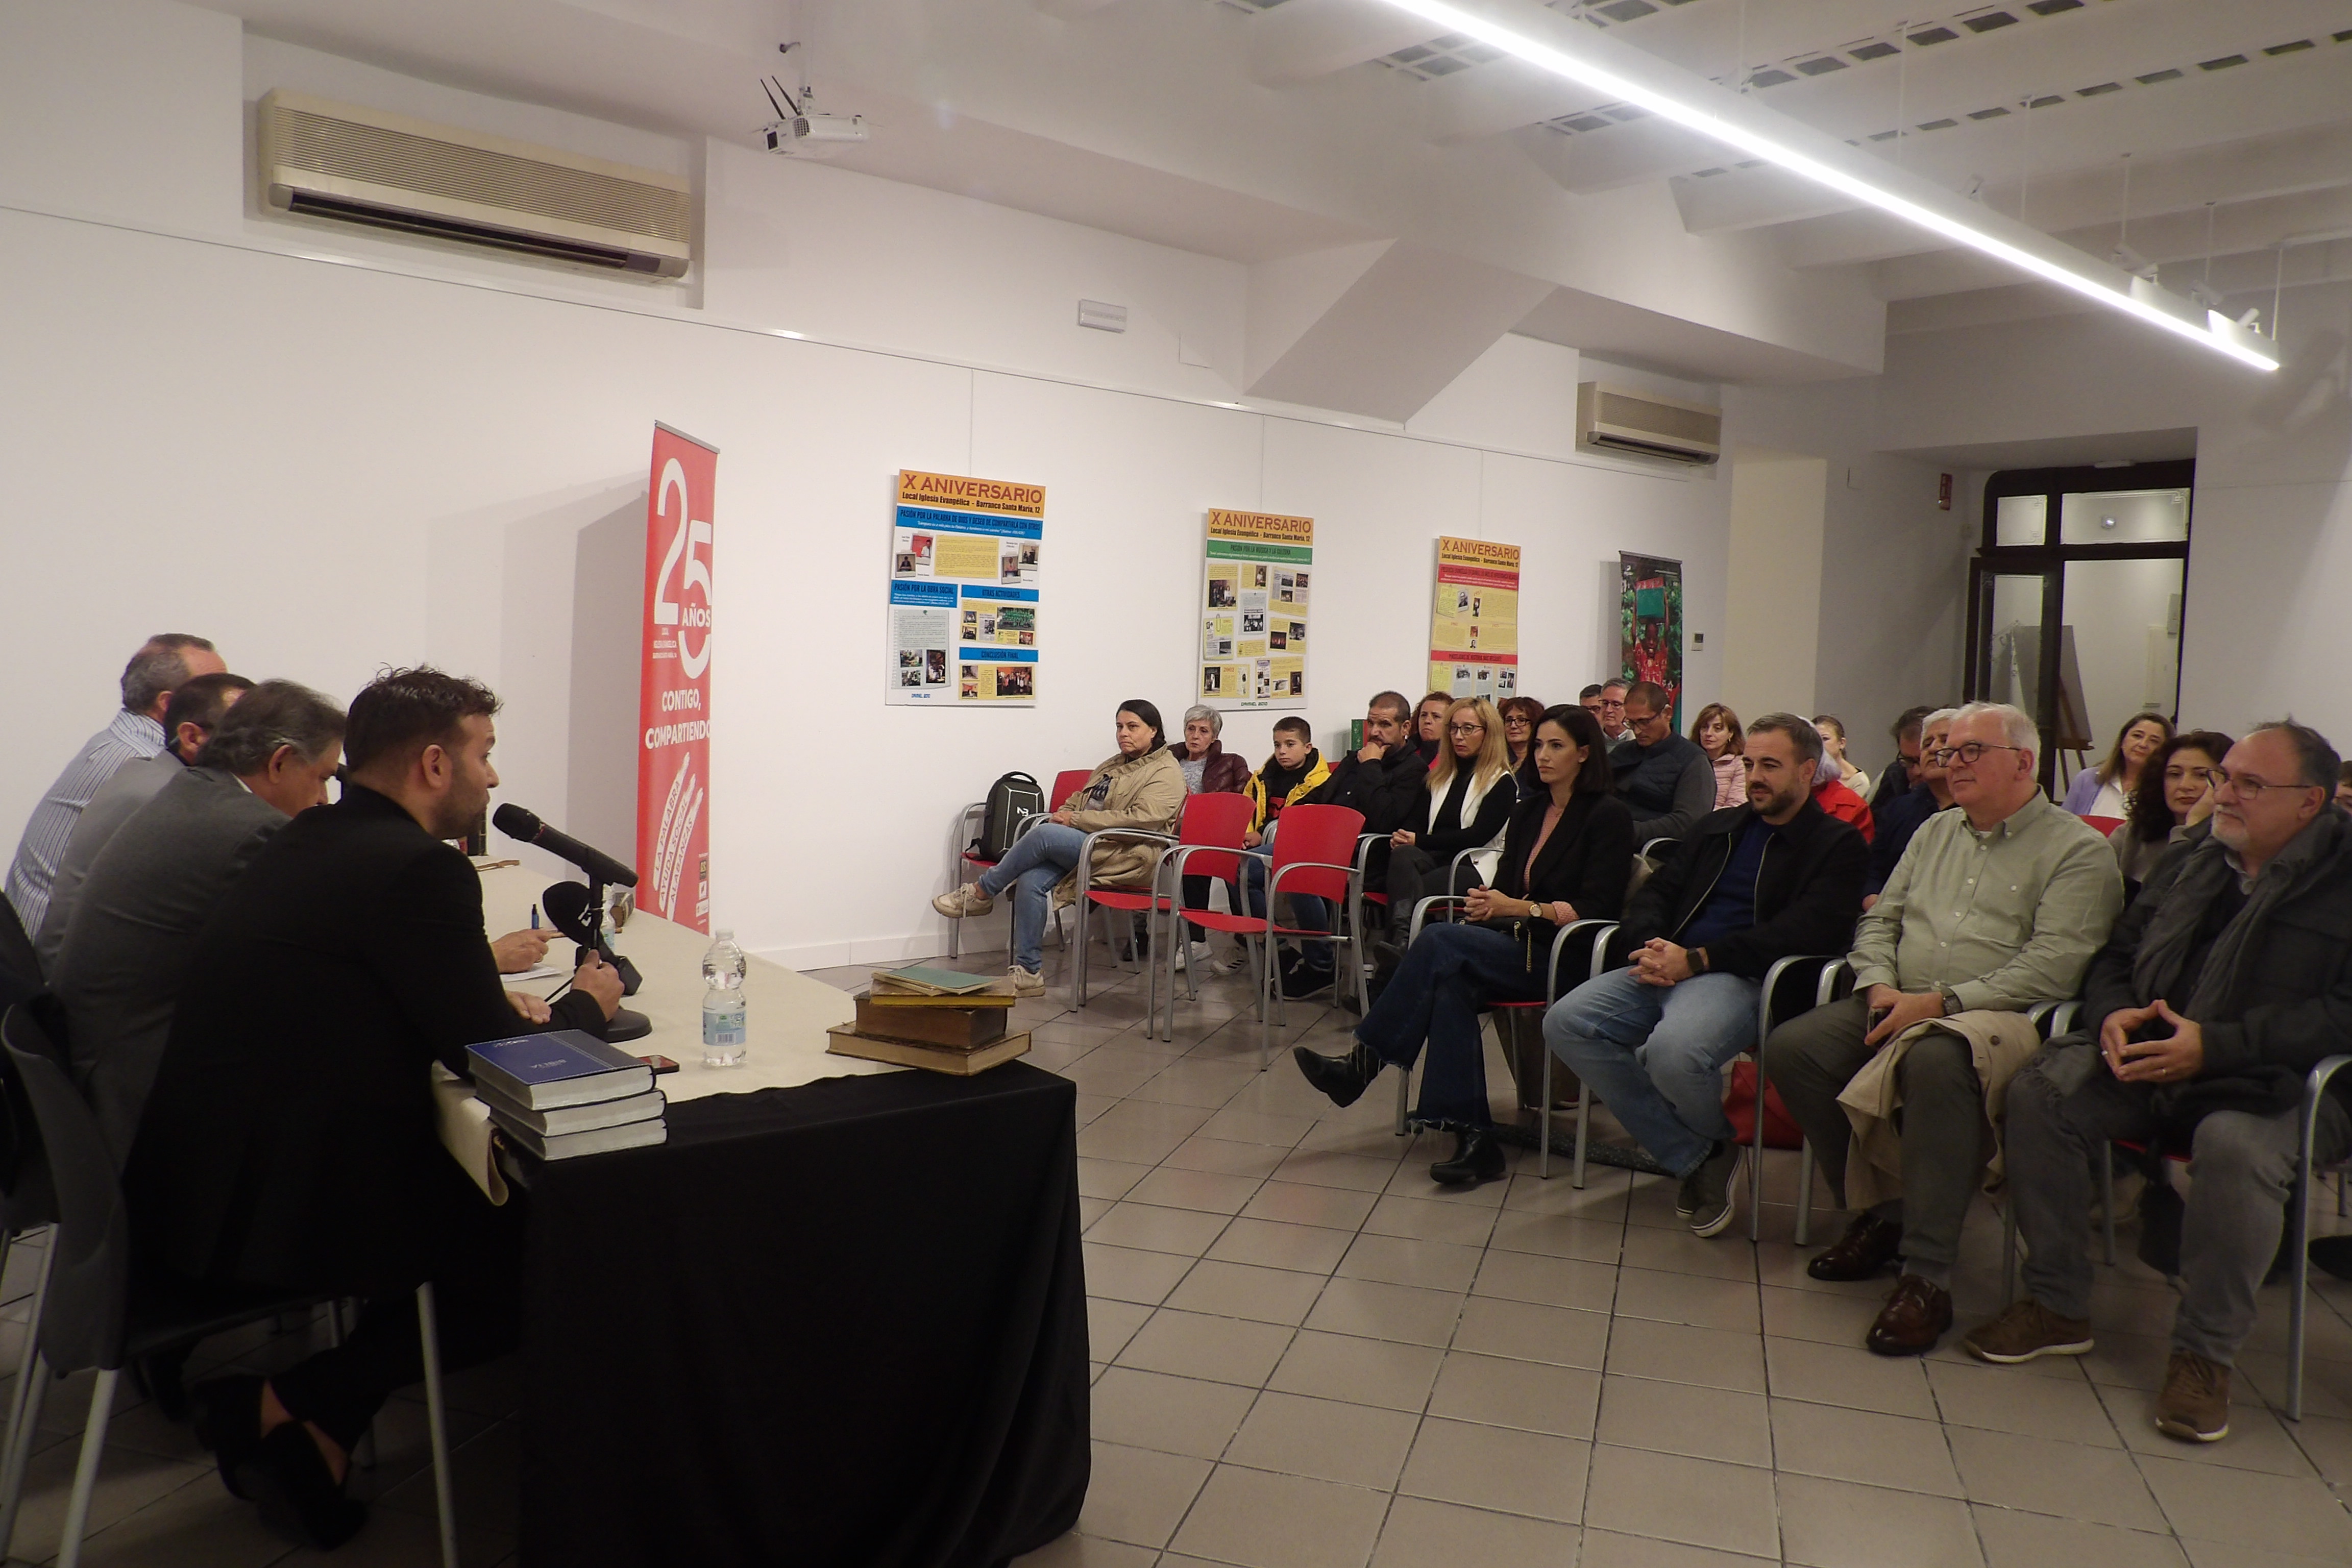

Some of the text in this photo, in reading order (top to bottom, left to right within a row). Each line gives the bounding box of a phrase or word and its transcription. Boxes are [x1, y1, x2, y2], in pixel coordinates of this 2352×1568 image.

[902, 492, 918, 500] Local
[919, 493, 939, 502] Iglesia
[940, 496, 970, 506] Evangélica
[976, 500, 1001, 509] Barranco
[1002, 503, 1017, 511] Santa
[903, 474, 1042, 503] X ANIVERSARIO
[1211, 512, 1311, 533] X ANIVERSARIO
[1442, 540, 1520, 560] X ANIVERSARIO
[654, 457, 712, 679] 25
[682, 602, 711, 627] AÑOS
[662, 689, 701, 712] CONTIGO,
[645, 719, 710, 749] COMPARTIENDO
[655, 781, 680, 871] LA PALABRA
[660, 797, 689, 902] AYUDA SOCIAL
[670, 817, 693, 903] ALABANZAS
